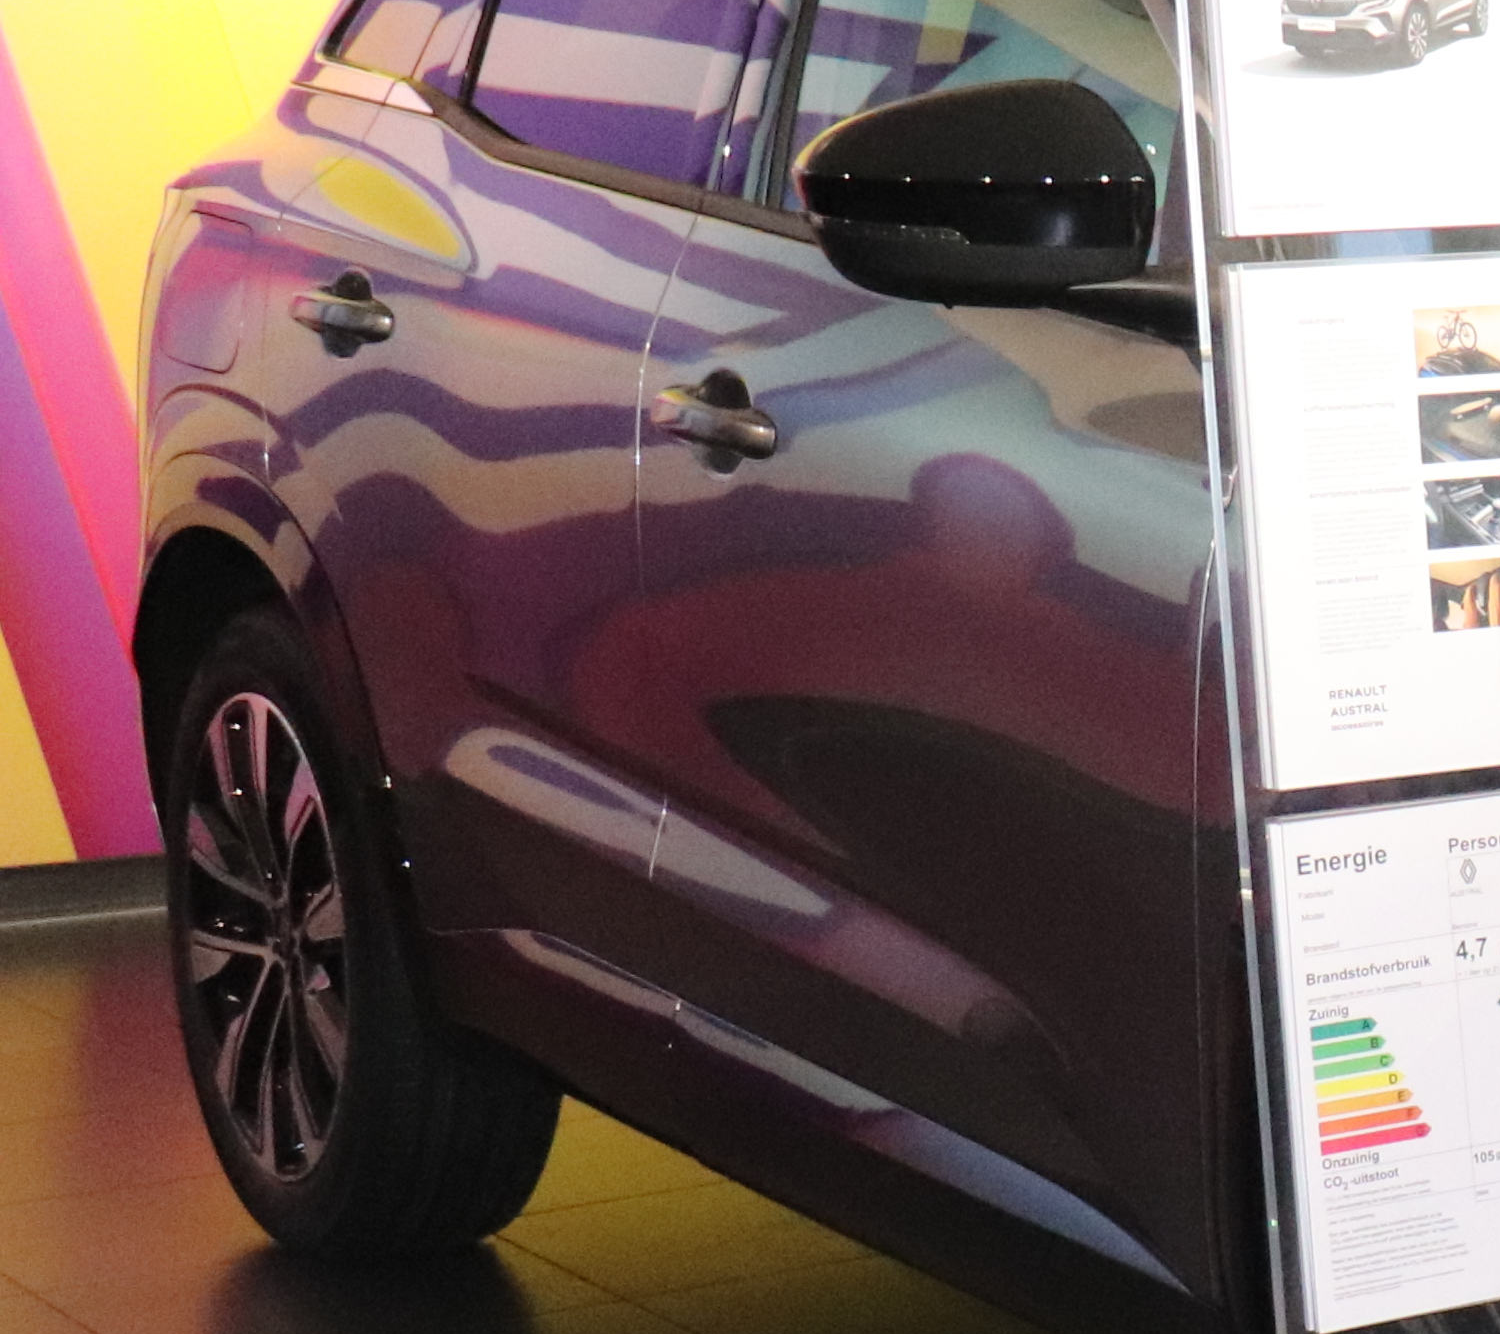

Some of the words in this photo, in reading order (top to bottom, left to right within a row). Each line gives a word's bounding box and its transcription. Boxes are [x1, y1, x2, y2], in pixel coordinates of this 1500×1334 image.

[1328, 684, 1387, 700] RENAULT
[1330, 702, 1388, 718] AUSTRAL
[1296, 845, 1387, 877] Energie
[1455, 937, 1487, 962] 4,7
[1305, 955, 1432, 986] Brandstofverbruik
[1308, 1005, 1350, 1022] Zuinig
[1362, 1019, 1370, 1030] A
[1370, 1038, 1379, 1049] B
[1380, 1055, 1389, 1066] C
[1388, 1074, 1398, 1085] D
[1398, 1091, 1405, 1102] E
[1322, 1150, 1380, 1170] Onzuinig
